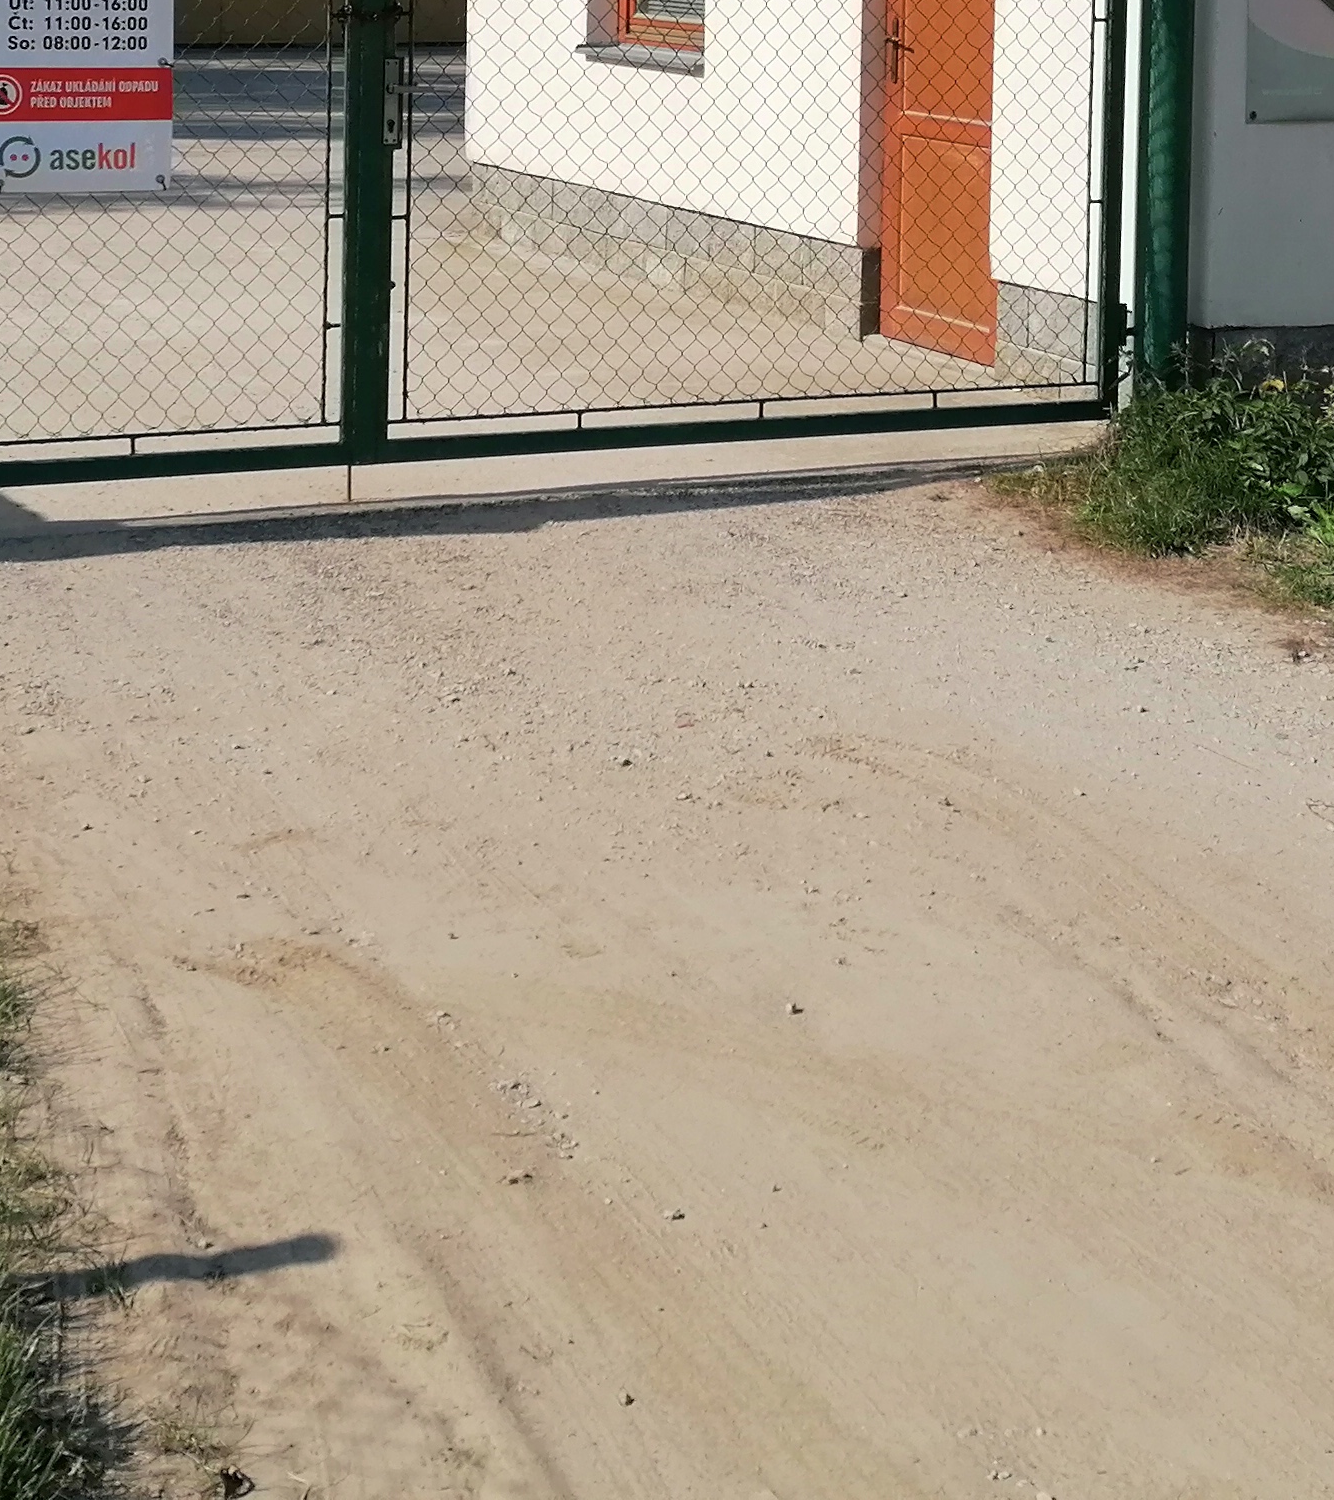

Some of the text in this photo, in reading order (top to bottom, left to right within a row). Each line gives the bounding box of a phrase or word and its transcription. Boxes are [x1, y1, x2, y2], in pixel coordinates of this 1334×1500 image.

[8, 12, 34, 31] Čt:
[7, 35, 36, 50] So:
[30, 78, 159, 93] ZÁKAZ UKLÁDÁNÍ ODPADU
[30, 93, 111, 108] PŘED OBJEKTEM
[50, 142, 136, 170] asekol
